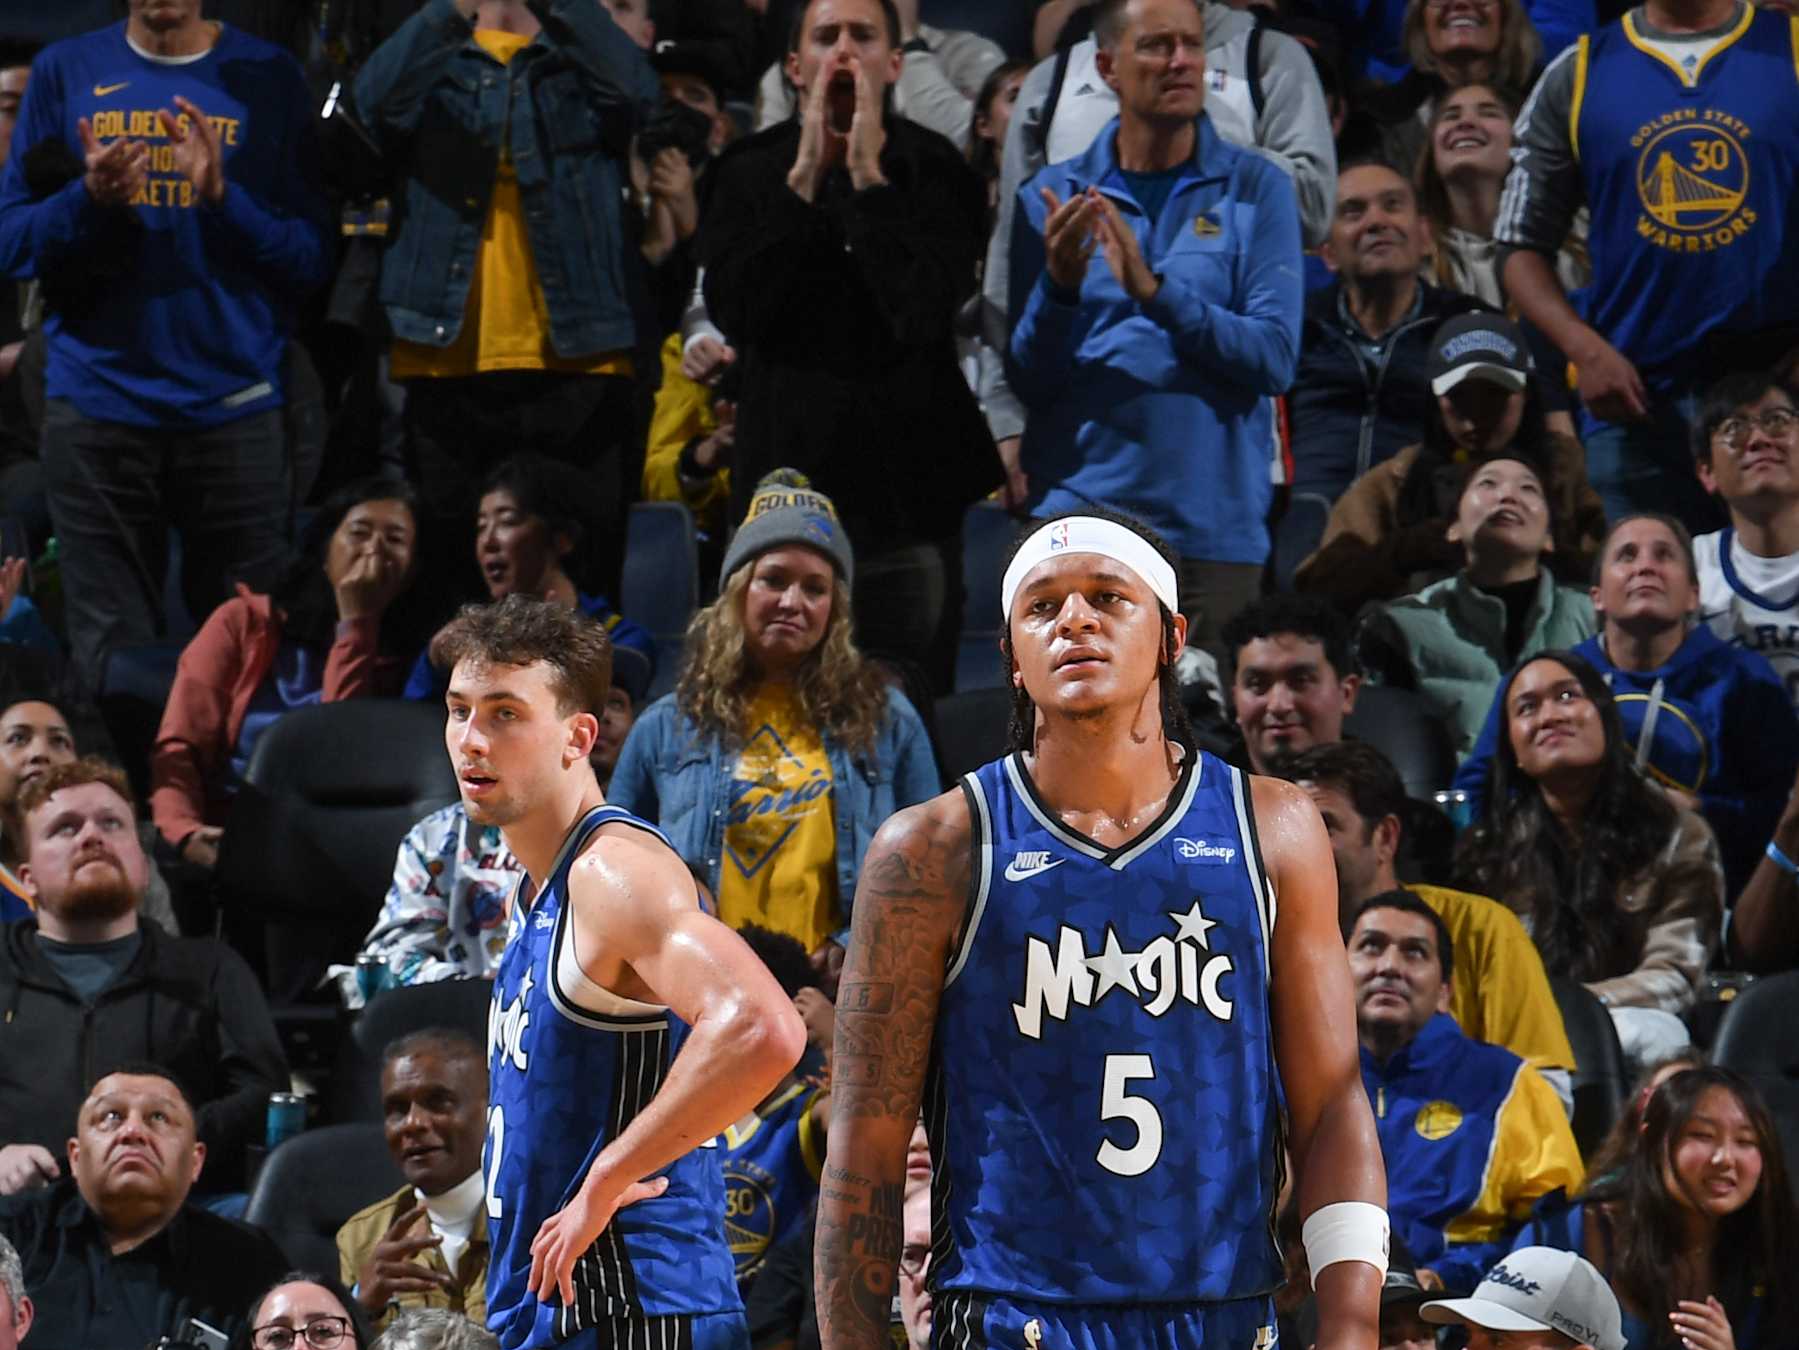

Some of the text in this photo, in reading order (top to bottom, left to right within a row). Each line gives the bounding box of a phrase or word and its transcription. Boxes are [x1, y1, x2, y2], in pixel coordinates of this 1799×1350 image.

[1630, 109, 1750, 148] GOLDEN STATE
[1690, 139, 1729, 172] 30
[1636, 206, 1758, 251] WARRIORS
[1014, 851, 1051, 869] NIKE
[1173, 837, 1236, 864] Disney
[1012, 901, 1233, 1040] Magic
[1096, 1054, 1164, 1177] 5
[725, 1187, 755, 1217] 30
